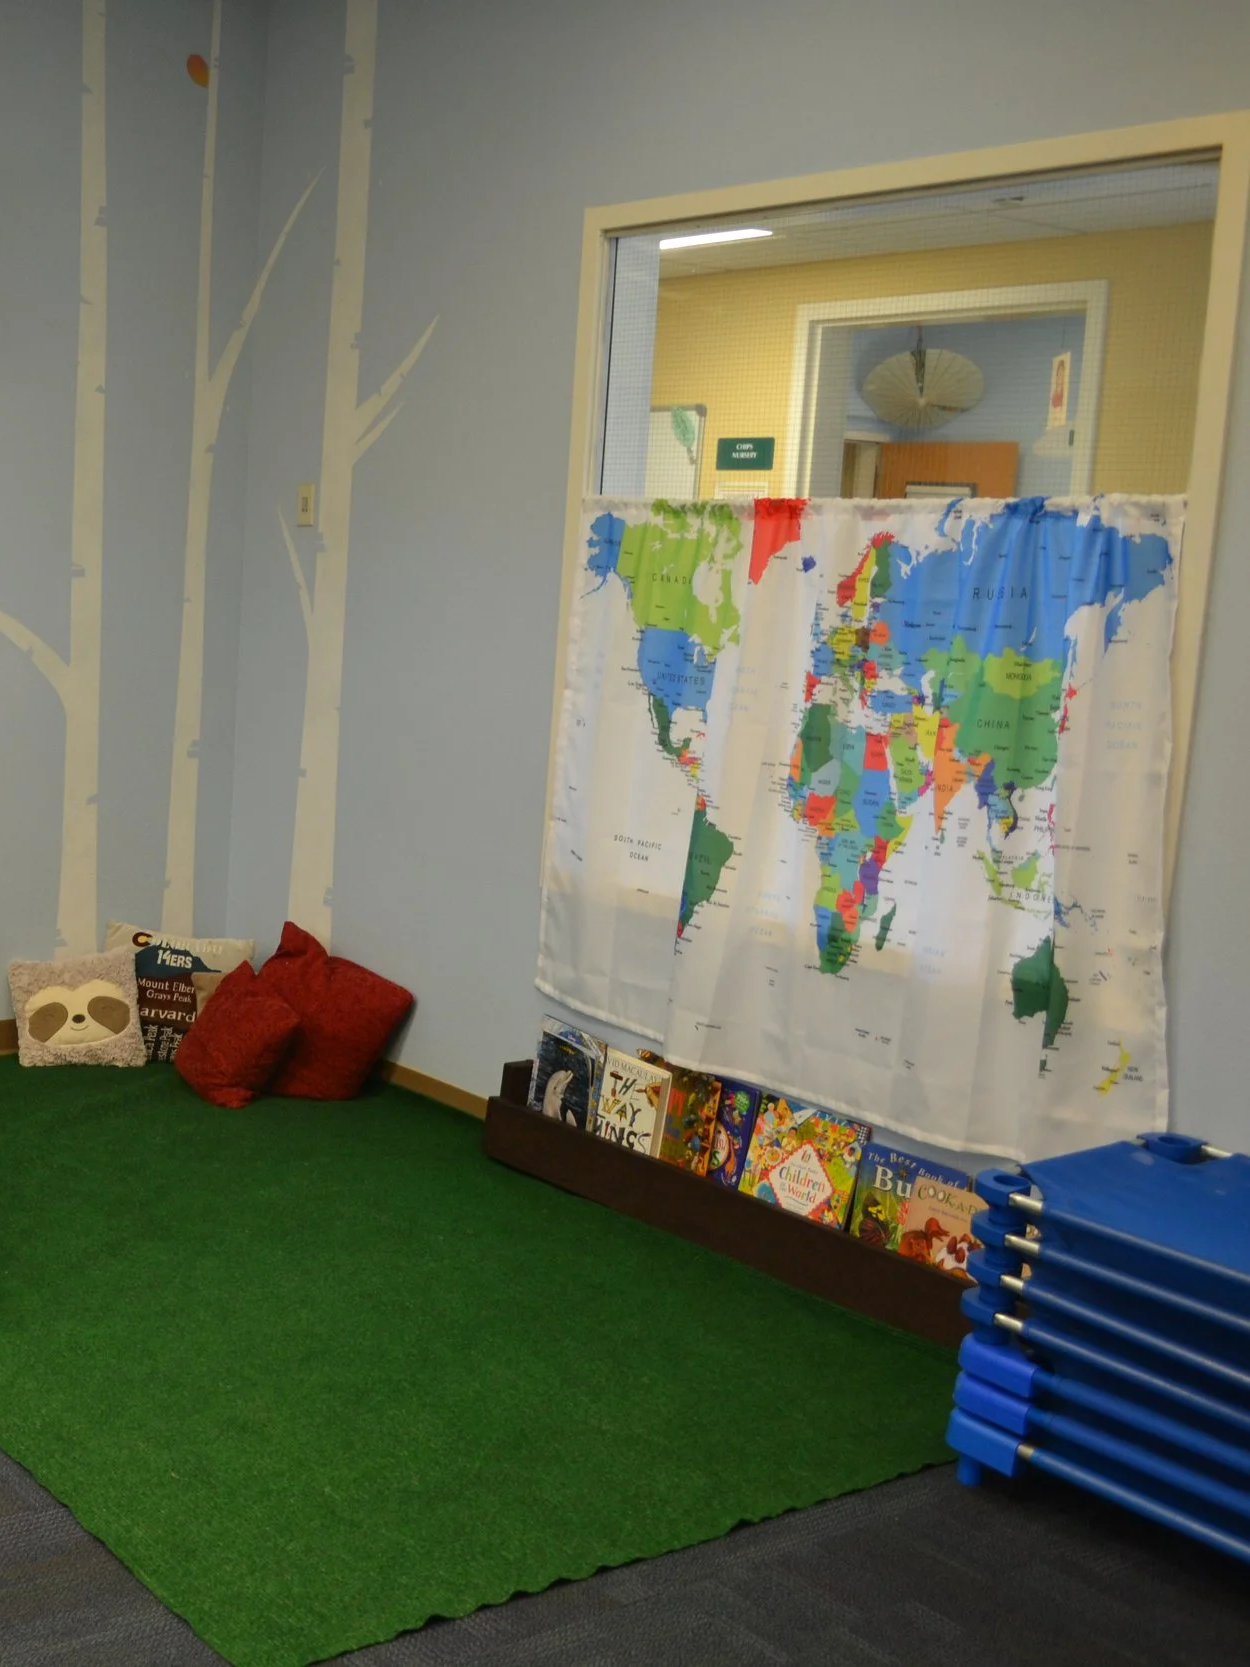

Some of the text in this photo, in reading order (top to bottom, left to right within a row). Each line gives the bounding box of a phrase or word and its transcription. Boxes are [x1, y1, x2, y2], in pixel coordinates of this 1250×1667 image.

[977, 719, 1010, 729] CHINA
[937, 784, 954, 792] NDIA
[613, 834, 662, 850] SOUTH PACIFIC
[629, 851, 649, 862] OCEAN
[157, 950, 193, 969] 14ERS
[138, 977, 169, 991] Mount
[146, 989, 192, 1004] Grays Peak
[140, 1006, 197, 1023] arvard
[610, 1070, 640, 1101] THE
[603, 1093, 642, 1127] WAY
[868, 1152, 886, 1164] The
[890, 1152, 917, 1168] Best
[918, 1167, 947, 1184] Book
[779, 1166, 825, 1193] Children
[788, 1183, 817, 1204] World
